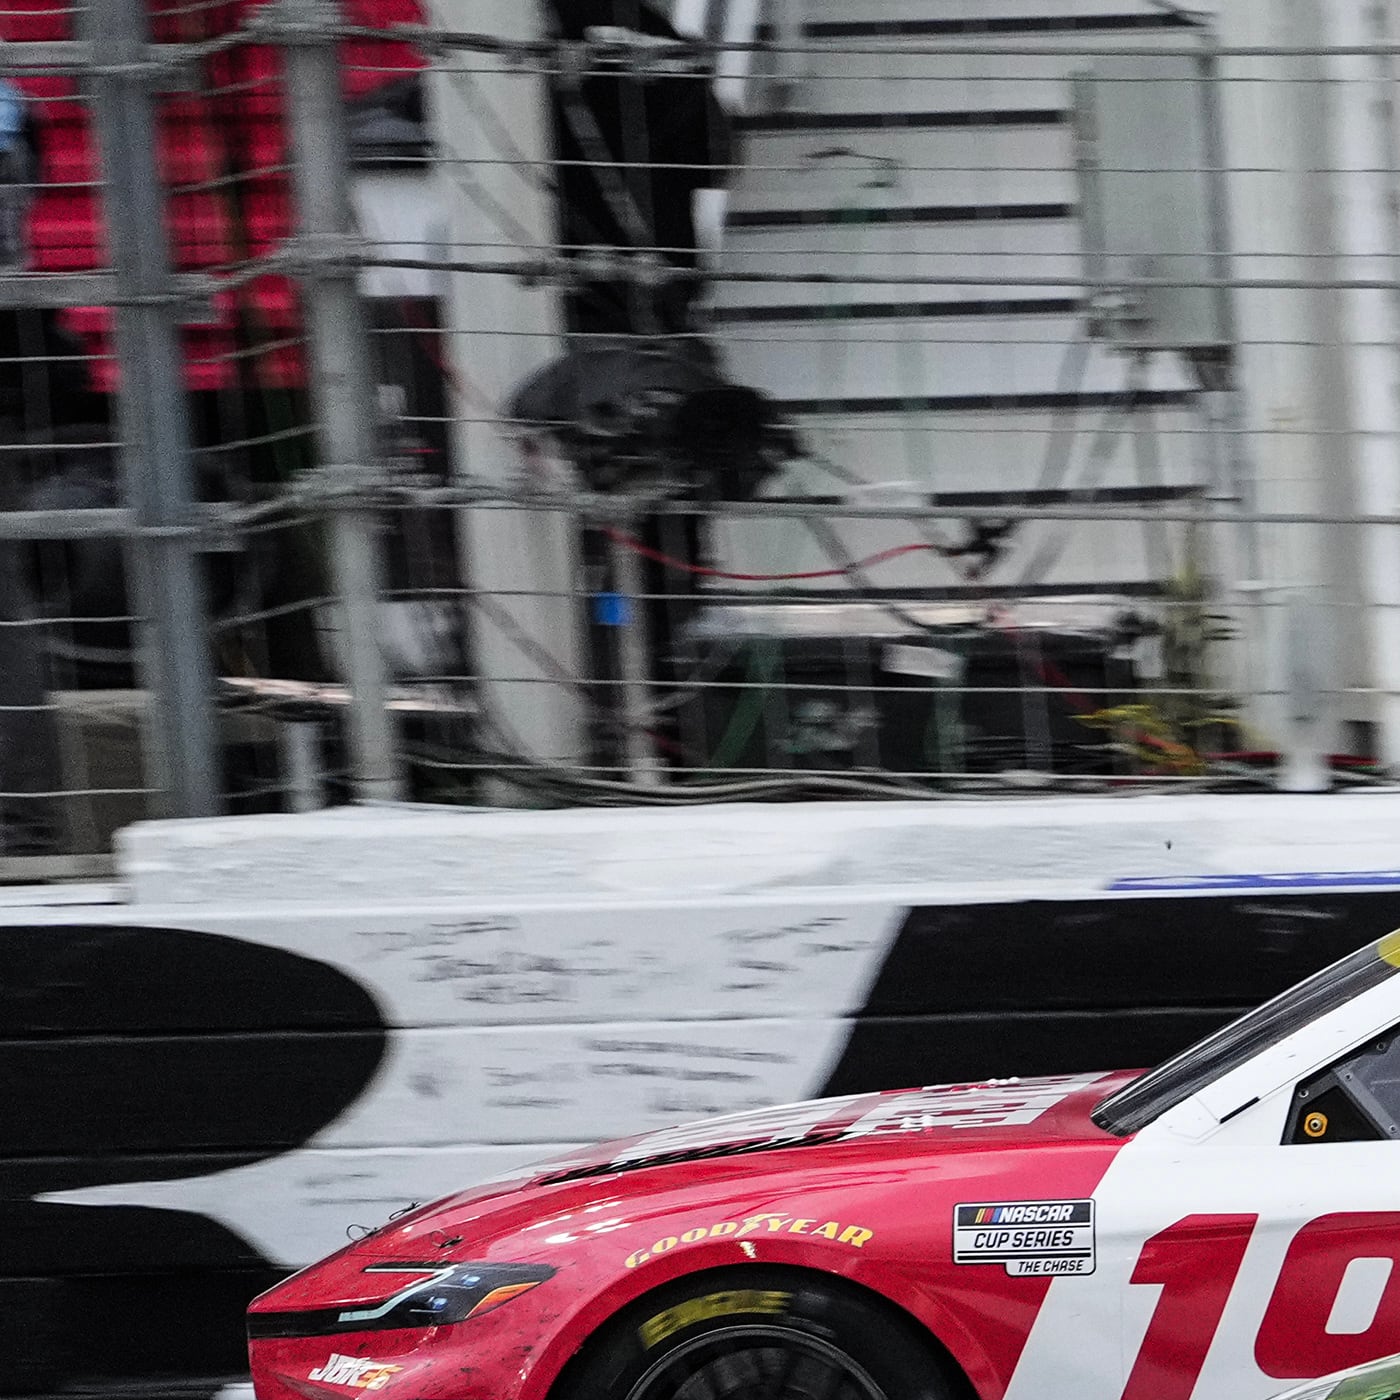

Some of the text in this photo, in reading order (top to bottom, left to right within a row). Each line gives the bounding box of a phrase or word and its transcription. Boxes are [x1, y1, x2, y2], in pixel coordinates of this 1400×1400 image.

[998, 1204, 1074, 1223] NASCAR
[624, 1212, 874, 1268] GOODYEAR
[974, 1230, 1074, 1249] CUP SERIES
[1018, 1259, 1084, 1273] THE CHASE
